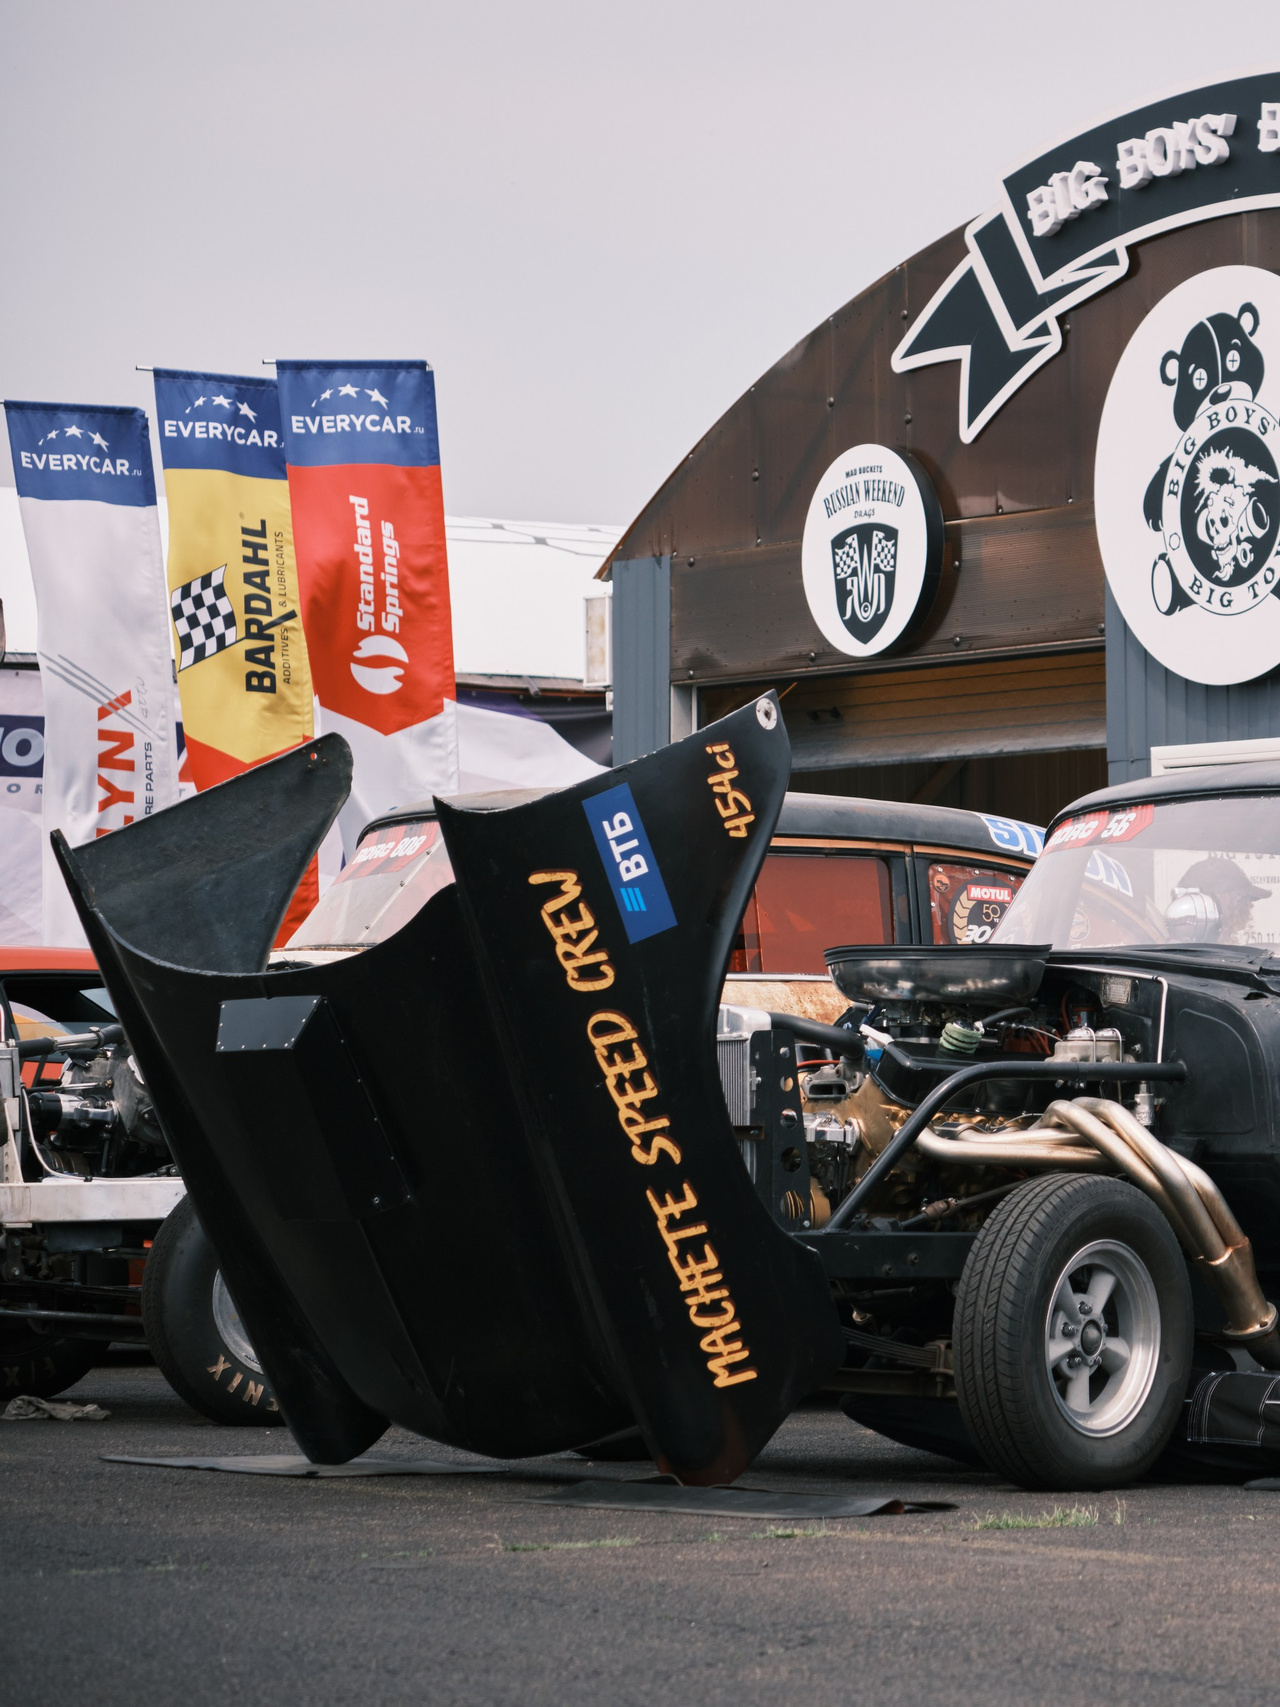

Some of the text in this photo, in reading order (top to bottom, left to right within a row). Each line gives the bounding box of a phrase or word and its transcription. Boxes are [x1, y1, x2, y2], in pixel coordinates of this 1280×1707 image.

[1026, 160, 1108, 237] BIG
[1117, 113, 1237, 190] BOYS'
[845, 465, 883, 478] MAD BUCKETS
[1167, 436, 1197, 499] BIG
[823, 478, 906, 518] RUSSIAN WEEKEND
[854, 508, 875, 519] DRAGS
[349, 495, 375, 632] Standard
[381, 520, 404, 634] Springs
[241, 519, 277, 694] BARDAHL
[274, 531, 291, 685] ADDITIVES & LUBRICANTS
[1188, 577, 1235, 608] BIG
[145, 741, 154, 792] PARTS
[602, 810, 649, 882] ВТБ
[1101, 812, 1136, 839] 56
[970, 887, 1011, 901] MOTUL
[982, 904, 1001, 922] 50
[528, 868, 758, 1389] MACHETE SPEED CREW
